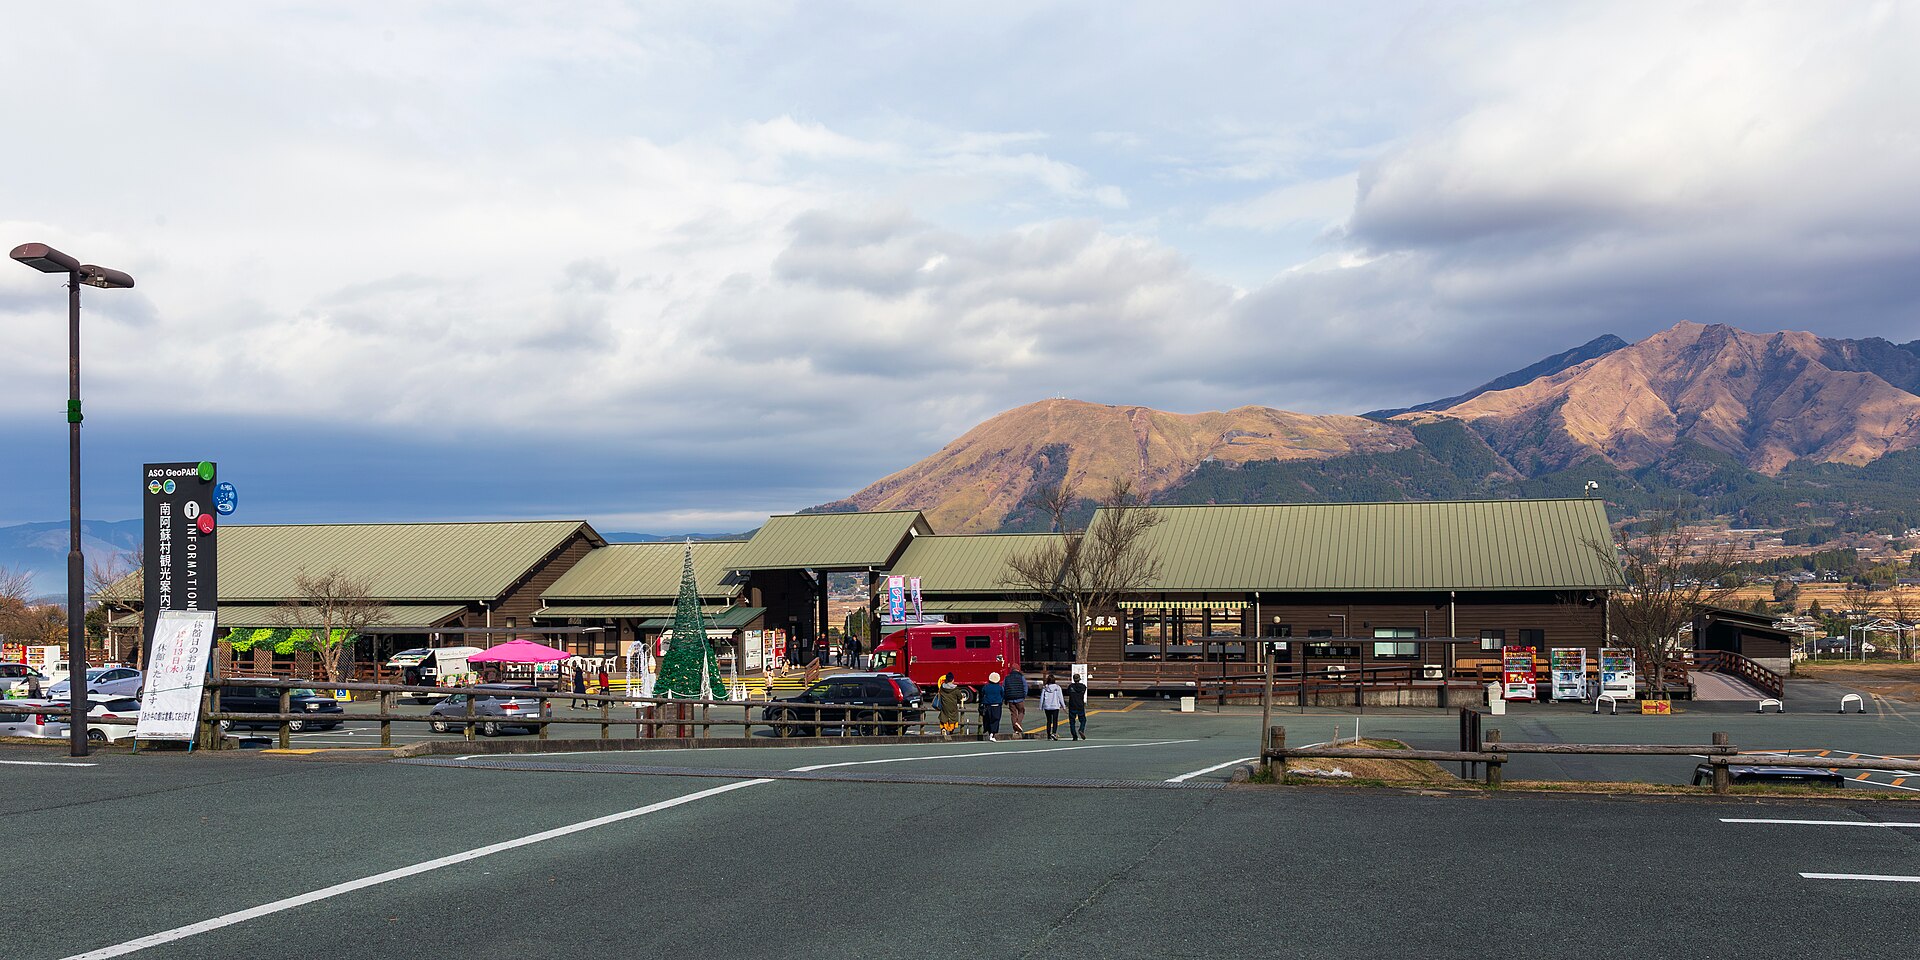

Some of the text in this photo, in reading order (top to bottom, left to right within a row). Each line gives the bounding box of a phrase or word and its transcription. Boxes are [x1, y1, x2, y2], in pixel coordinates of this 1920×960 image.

[148, 468, 199, 478] ASO GeoPAR
[187, 523, 198, 608] INFORMATION
